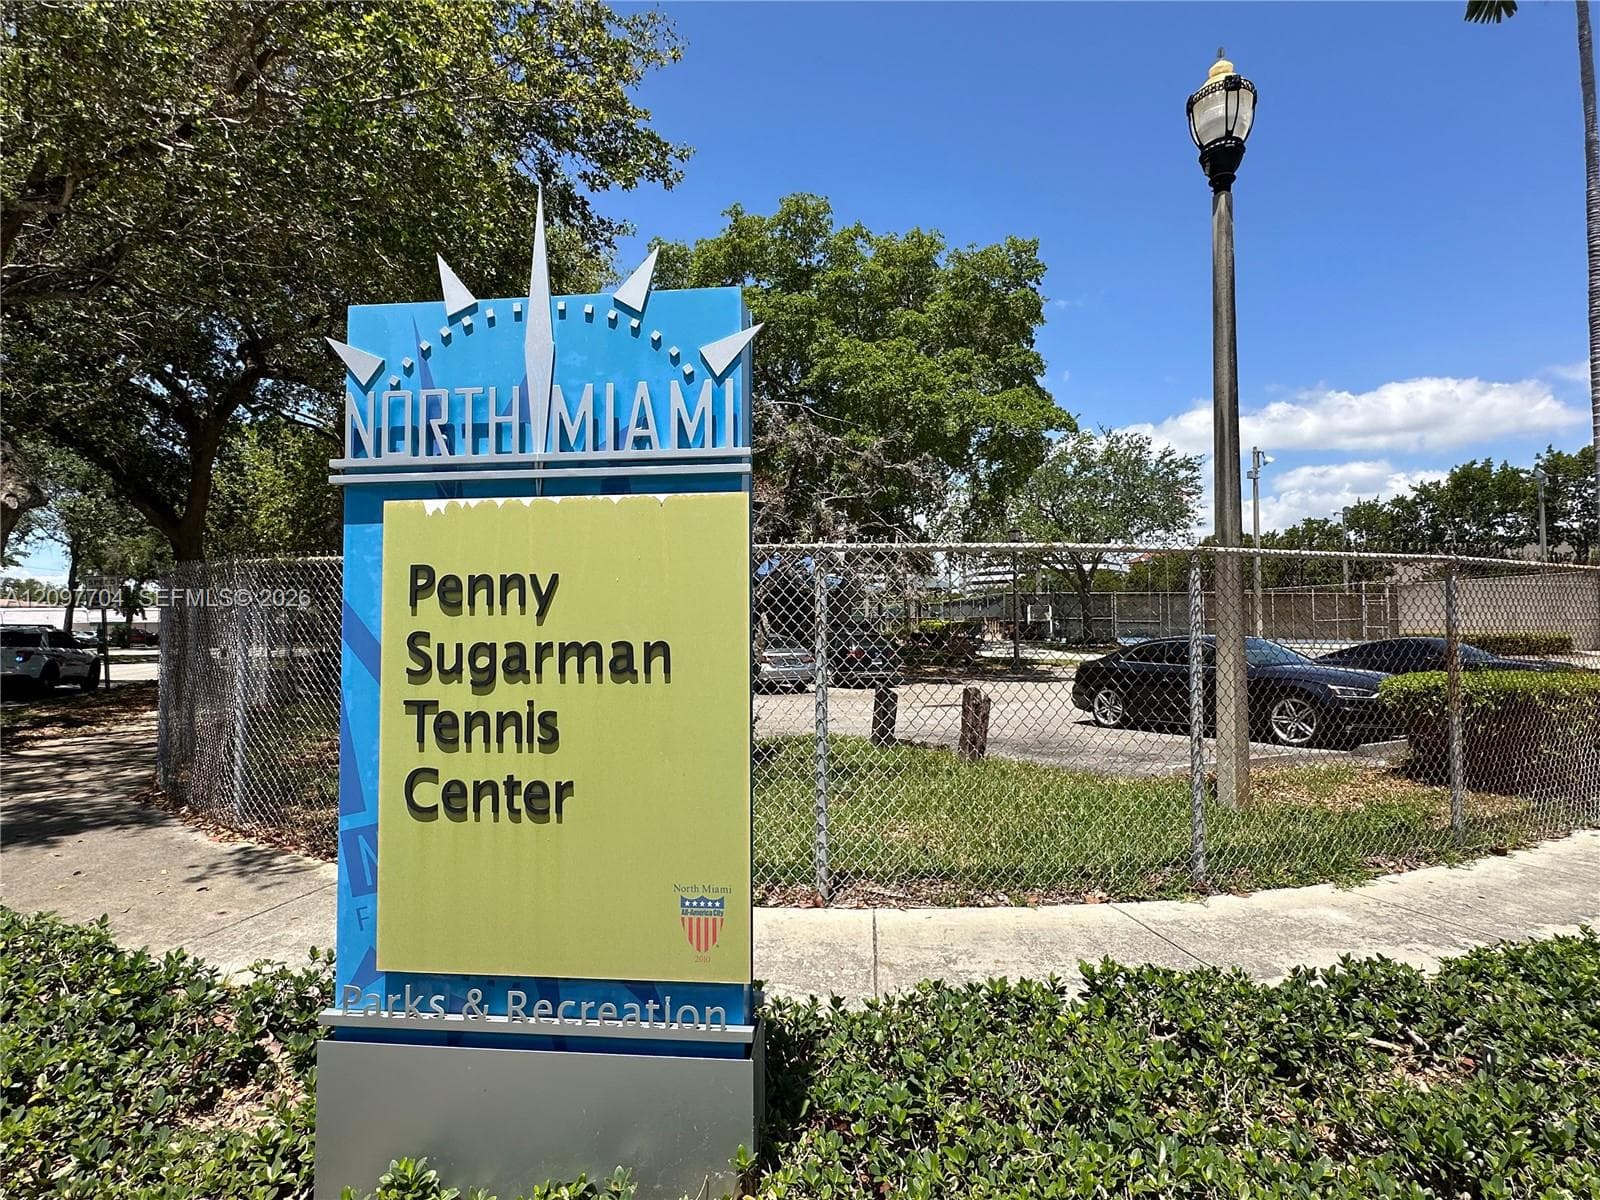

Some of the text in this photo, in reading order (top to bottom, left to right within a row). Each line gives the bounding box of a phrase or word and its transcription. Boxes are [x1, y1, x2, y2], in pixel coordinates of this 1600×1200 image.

[345, 377, 734, 459] NORTH MIAMI
[408, 564, 560, 621] Penny
[405, 630, 672, 692] Sugarman
[403, 699, 560, 752] Tennis
[403, 767, 575, 822] Center
[673, 883, 732, 894] North Miami
[713, 909, 724, 917] City
[342, 984, 728, 1031] Parks & Recreation
